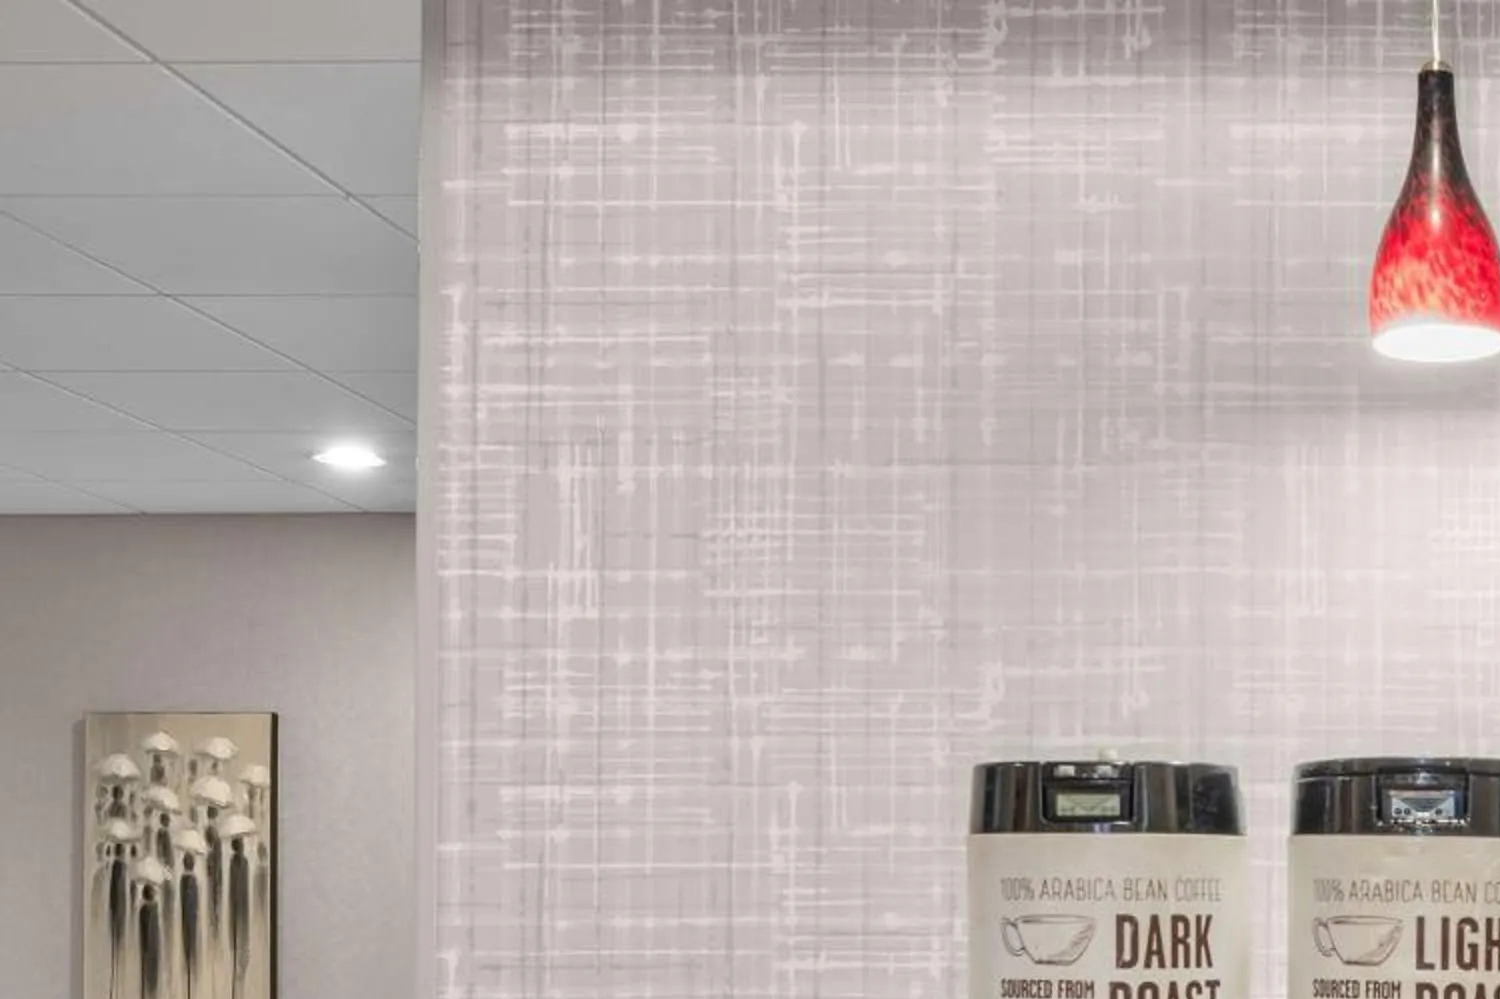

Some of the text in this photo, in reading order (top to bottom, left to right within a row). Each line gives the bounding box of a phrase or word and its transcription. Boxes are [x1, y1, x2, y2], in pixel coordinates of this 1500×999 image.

[1039, 879, 1115, 901] ARABICA
[1123, 878, 1168, 901] BEAN
[1175, 877, 1222, 902] COFFEE
[1348, 879, 1424, 903] ARABICA
[1431, 881, 1477, 903] BEAN
[1115, 914, 1213, 969] DARK
[1001, 978, 1095, 999] SOURCED FROM
[1312, 978, 1361, 999] SOURCED
